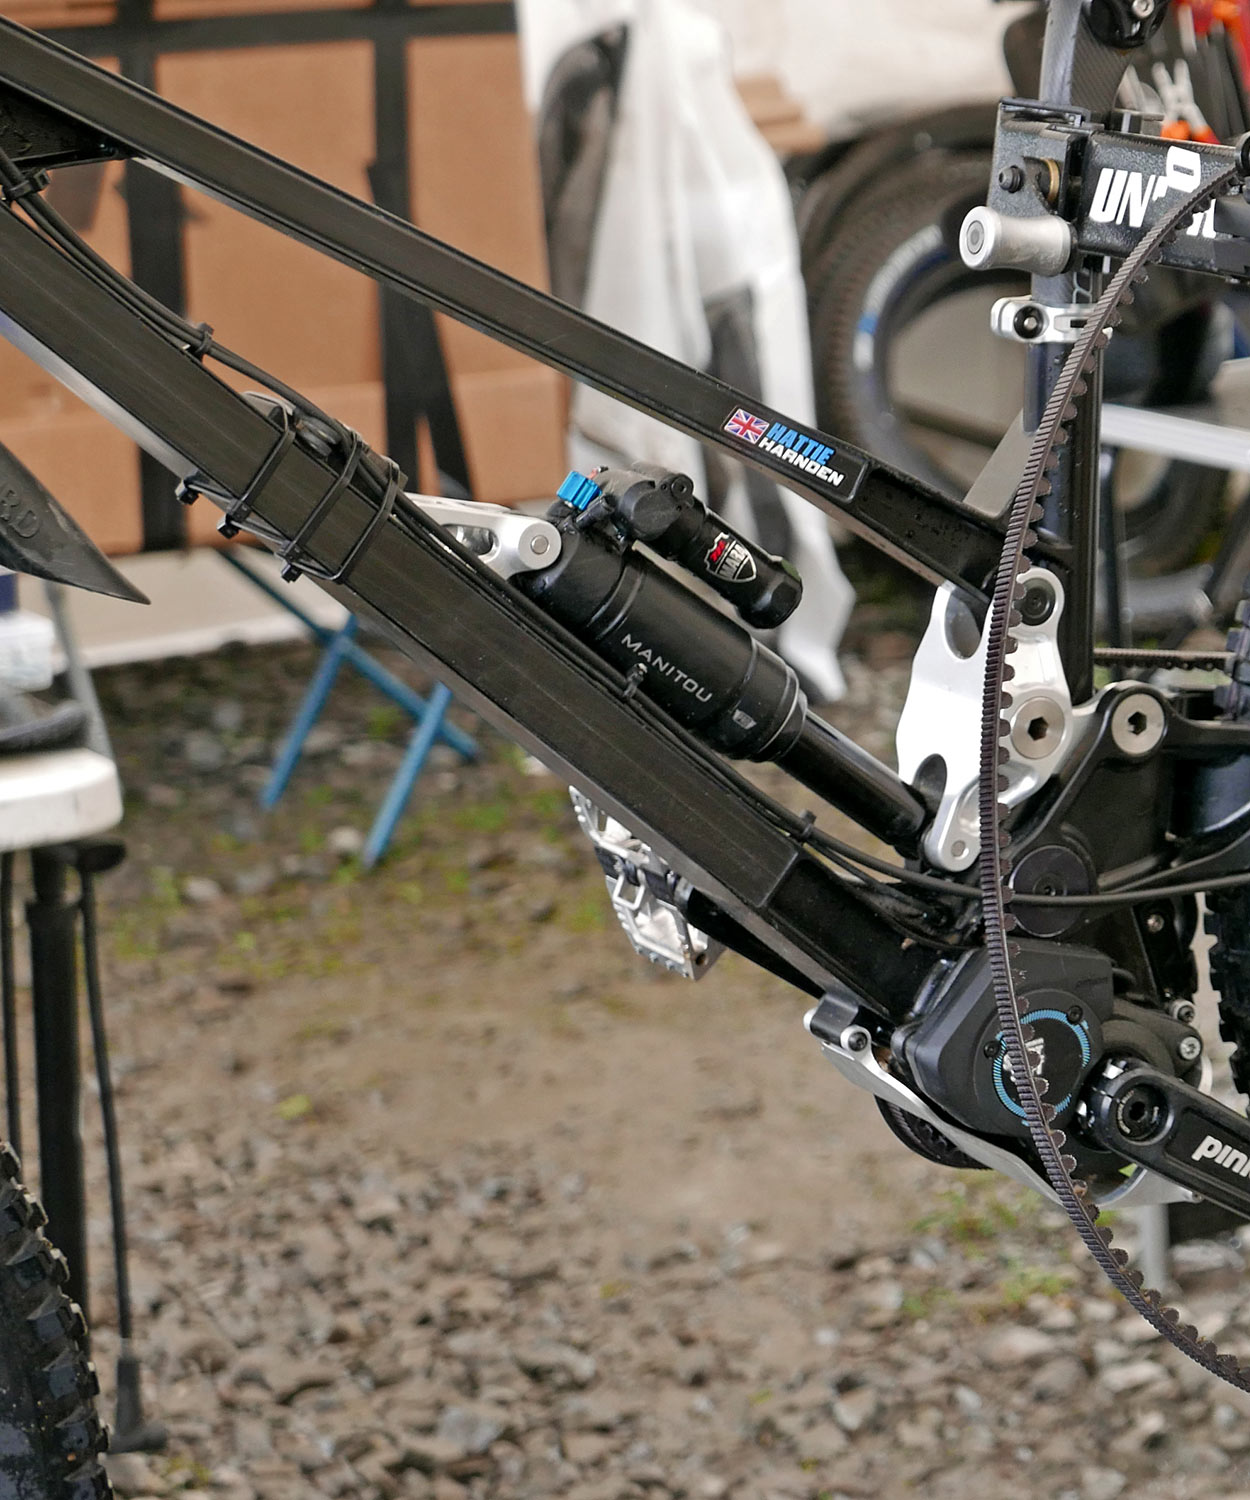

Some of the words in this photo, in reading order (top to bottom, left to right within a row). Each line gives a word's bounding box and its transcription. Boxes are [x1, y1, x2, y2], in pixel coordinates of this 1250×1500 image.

[758, 437, 845, 486] HARNDEN
[766, 421, 834, 466] HATTIE
[621, 633, 713, 702] MANITOU
